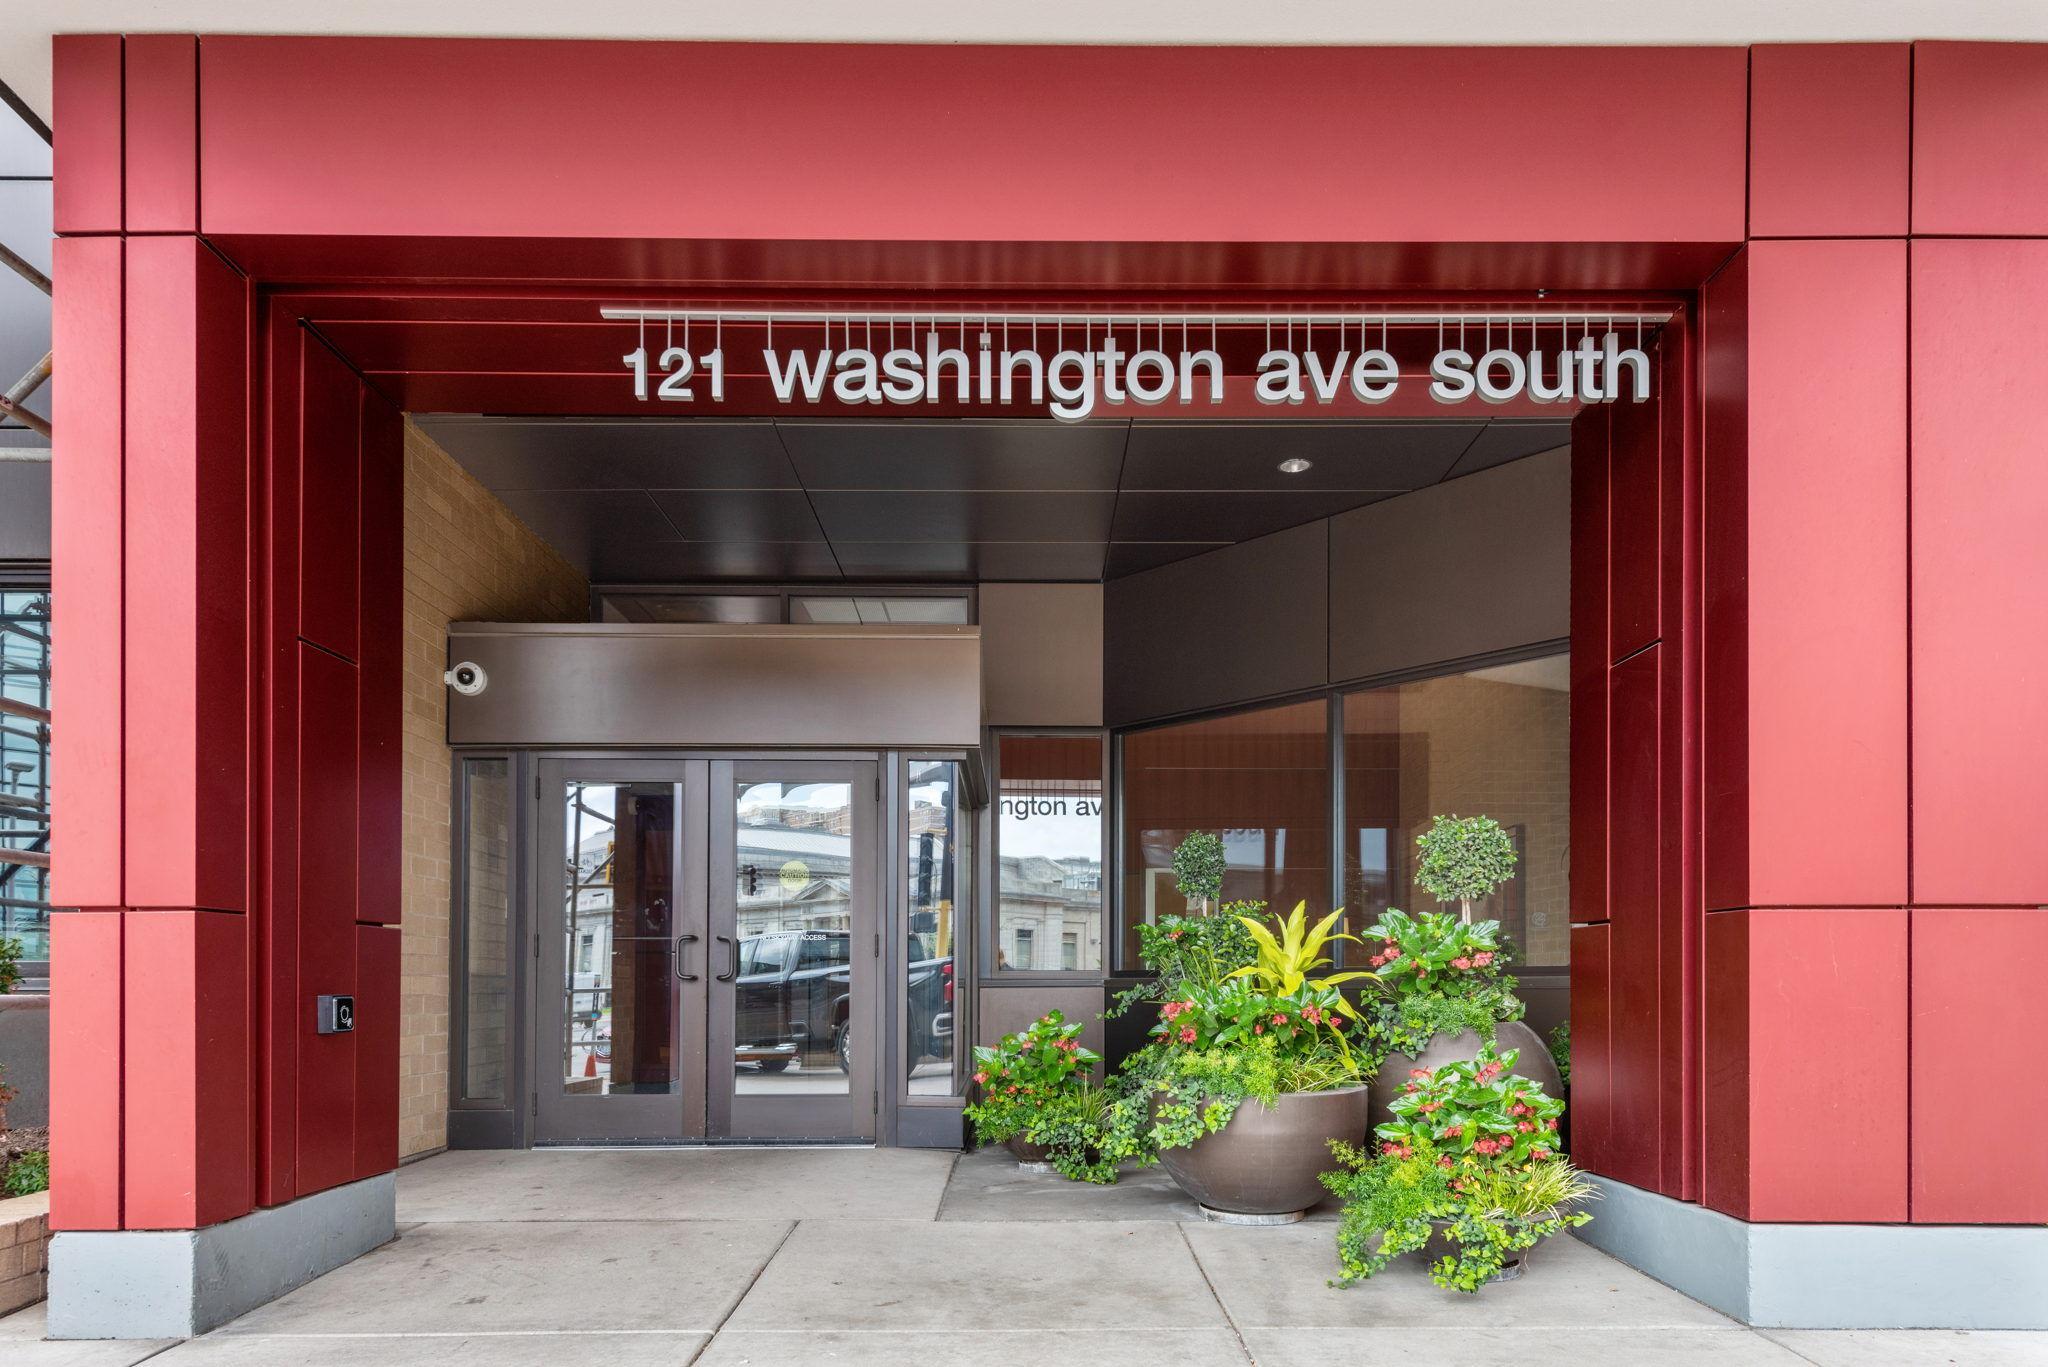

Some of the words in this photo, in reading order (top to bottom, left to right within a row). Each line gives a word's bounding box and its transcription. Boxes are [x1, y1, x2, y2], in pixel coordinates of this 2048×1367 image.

[622, 347, 725, 402] 121
[763, 332, 1224, 422] washington
[1256, 348, 1400, 405] ave
[1430, 332, 1651, 404] south
